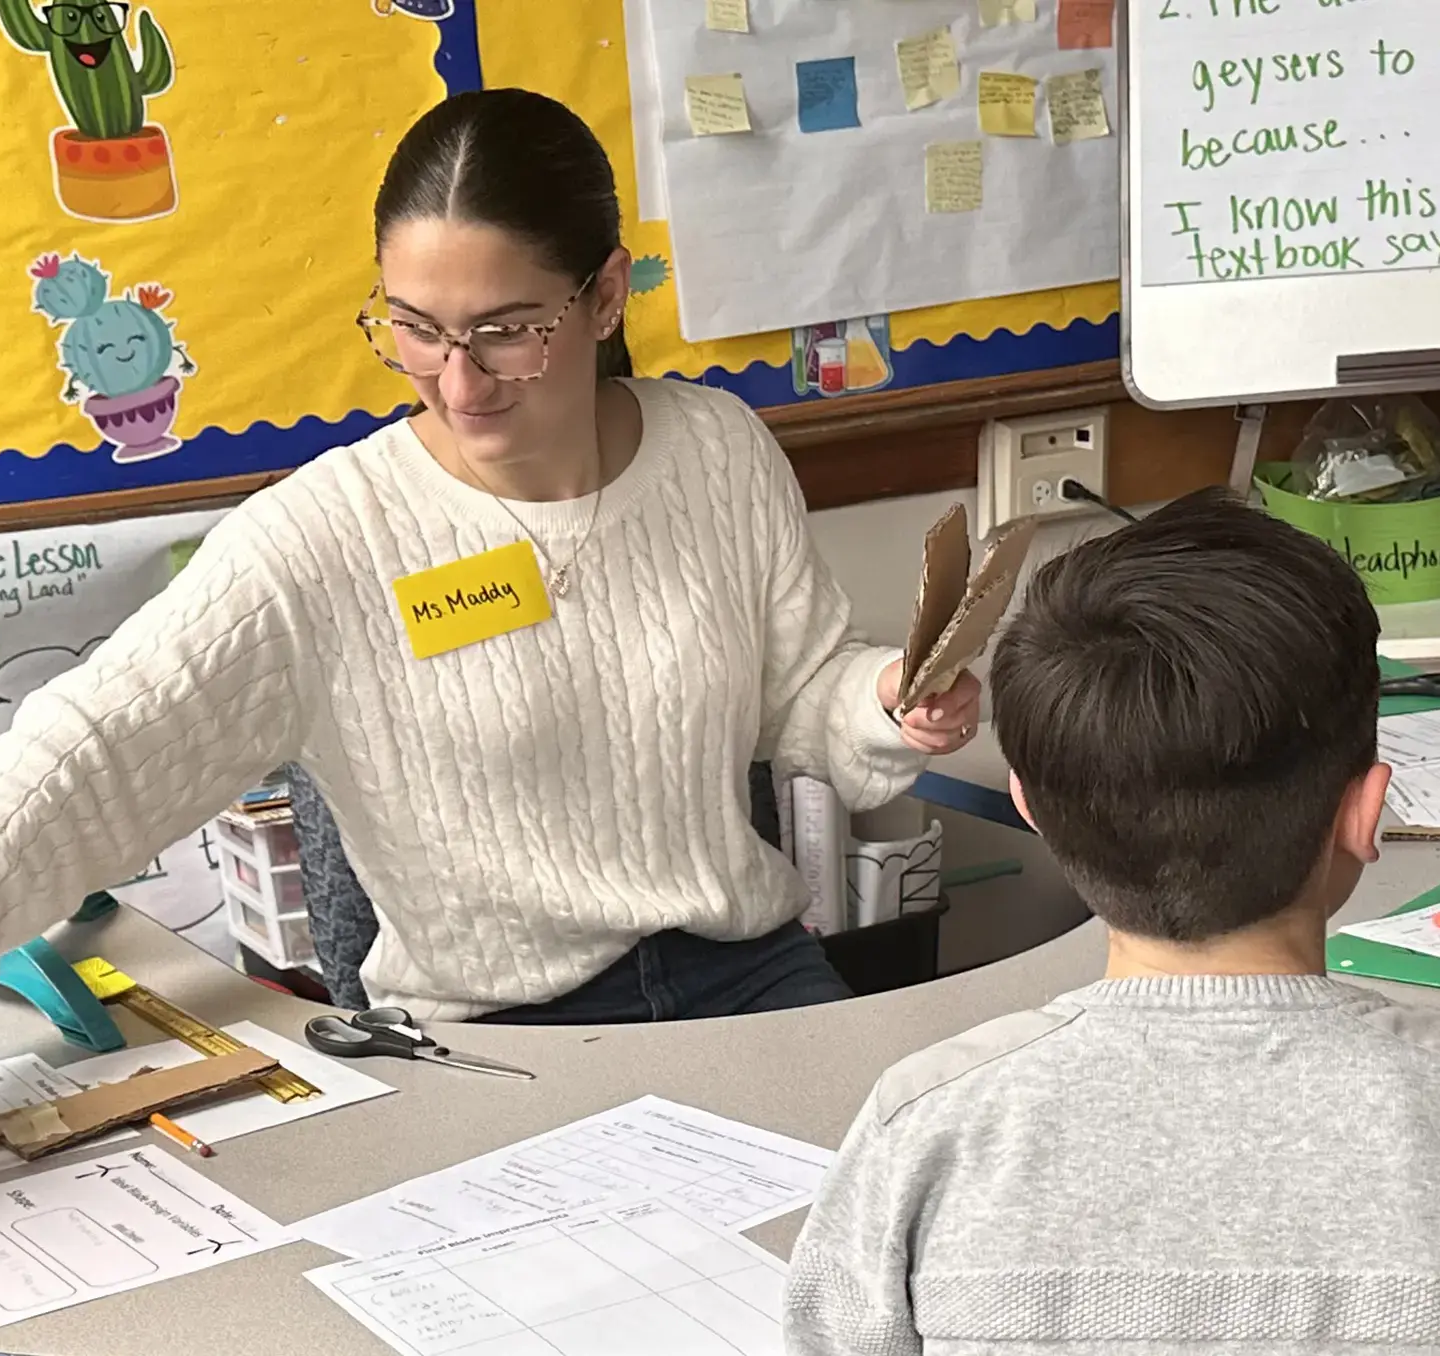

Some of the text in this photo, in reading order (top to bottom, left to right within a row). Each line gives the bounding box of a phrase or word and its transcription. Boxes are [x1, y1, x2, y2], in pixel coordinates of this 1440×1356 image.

[1192, 49, 1344, 112] geysers
[1370, 39, 1415, 75] to
[1164, 201, 1203, 236] I
[1230, 195, 1338, 235] know
[1357, 176, 1437, 221] this
[1186, 232, 1365, 279] textbook
[12, 540, 103, 579] Lesson
[445, 582, 520, 614] Maddy
